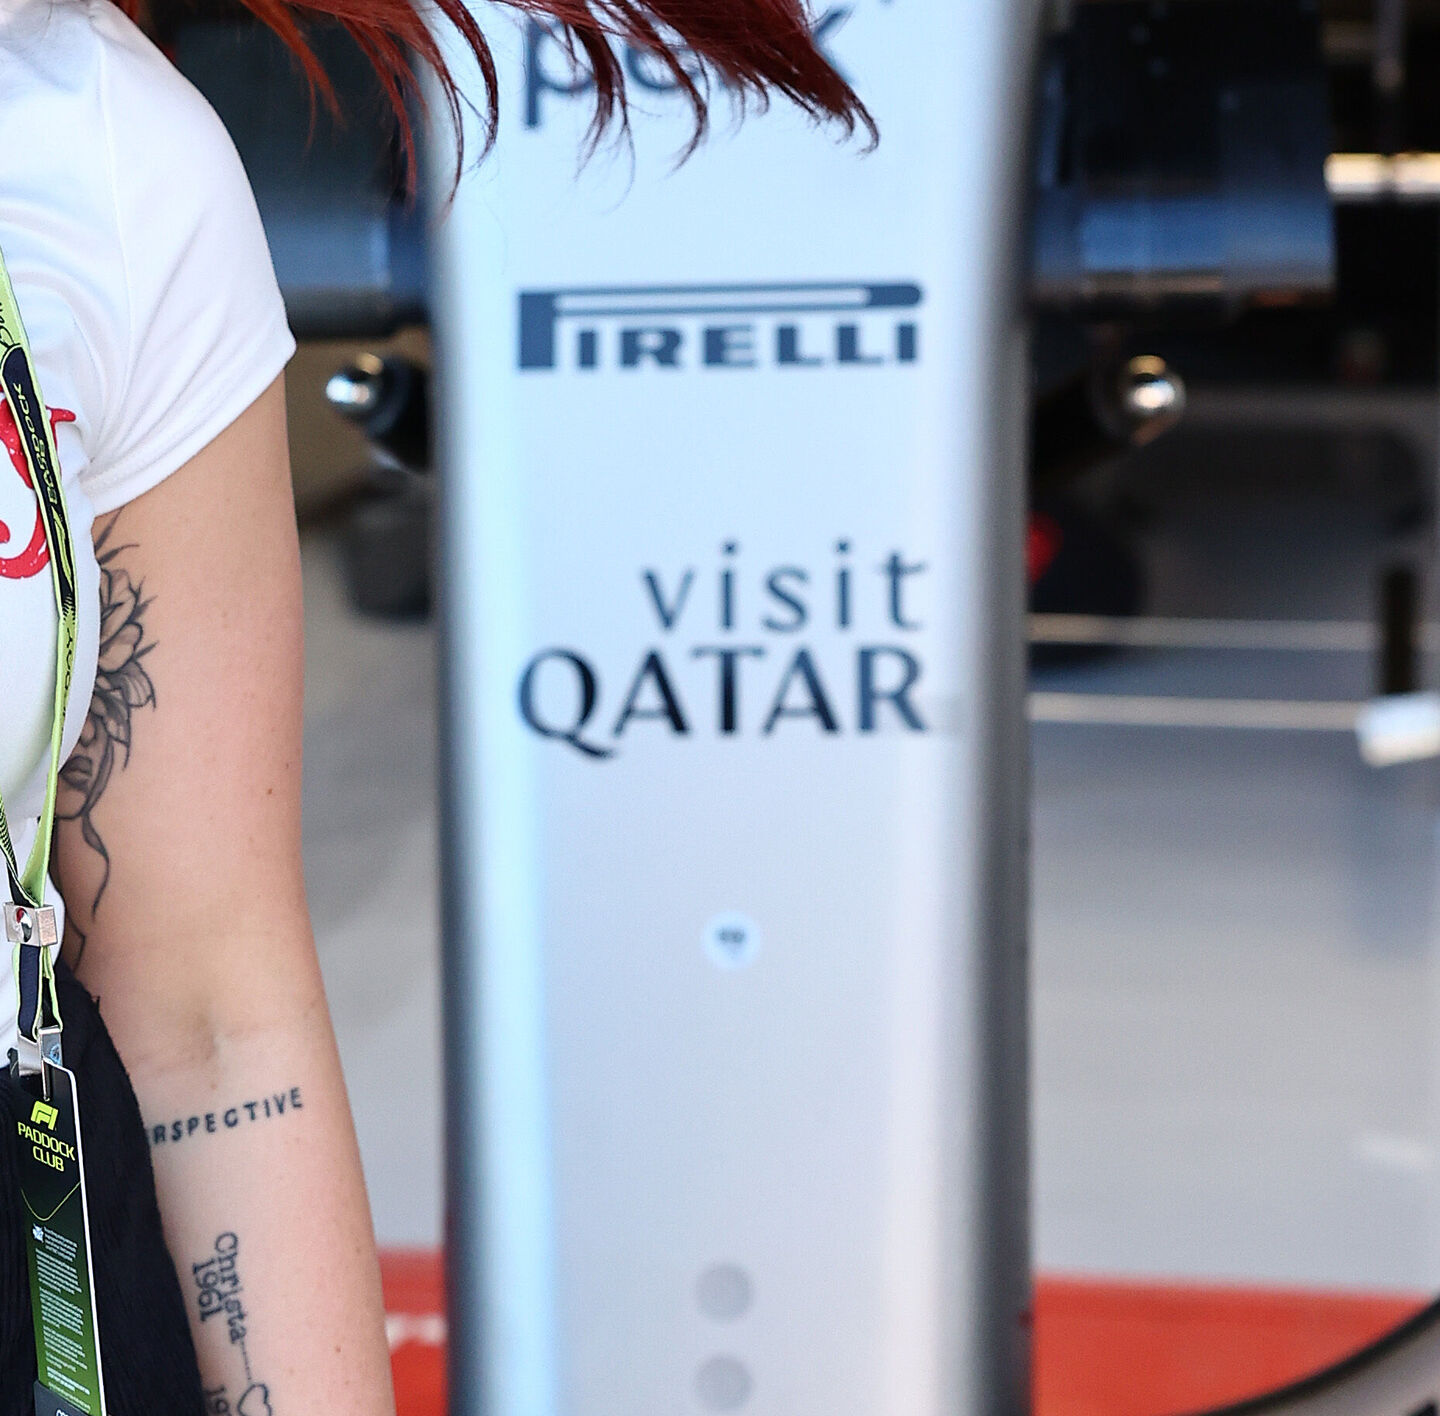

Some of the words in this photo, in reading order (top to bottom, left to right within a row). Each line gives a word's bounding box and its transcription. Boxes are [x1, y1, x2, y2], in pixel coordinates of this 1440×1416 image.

[517, 281, 924, 372] PIRELLI
[643, 540, 927, 633] visit
[517, 644, 928, 759] QATAR
[17, 1121, 76, 1162] PADDOCK
[32, 1145, 65, 1172] CLUB
[152, 1087, 304, 1145] RSPECTIVE
[214, 1231, 247, 1345] Christa
